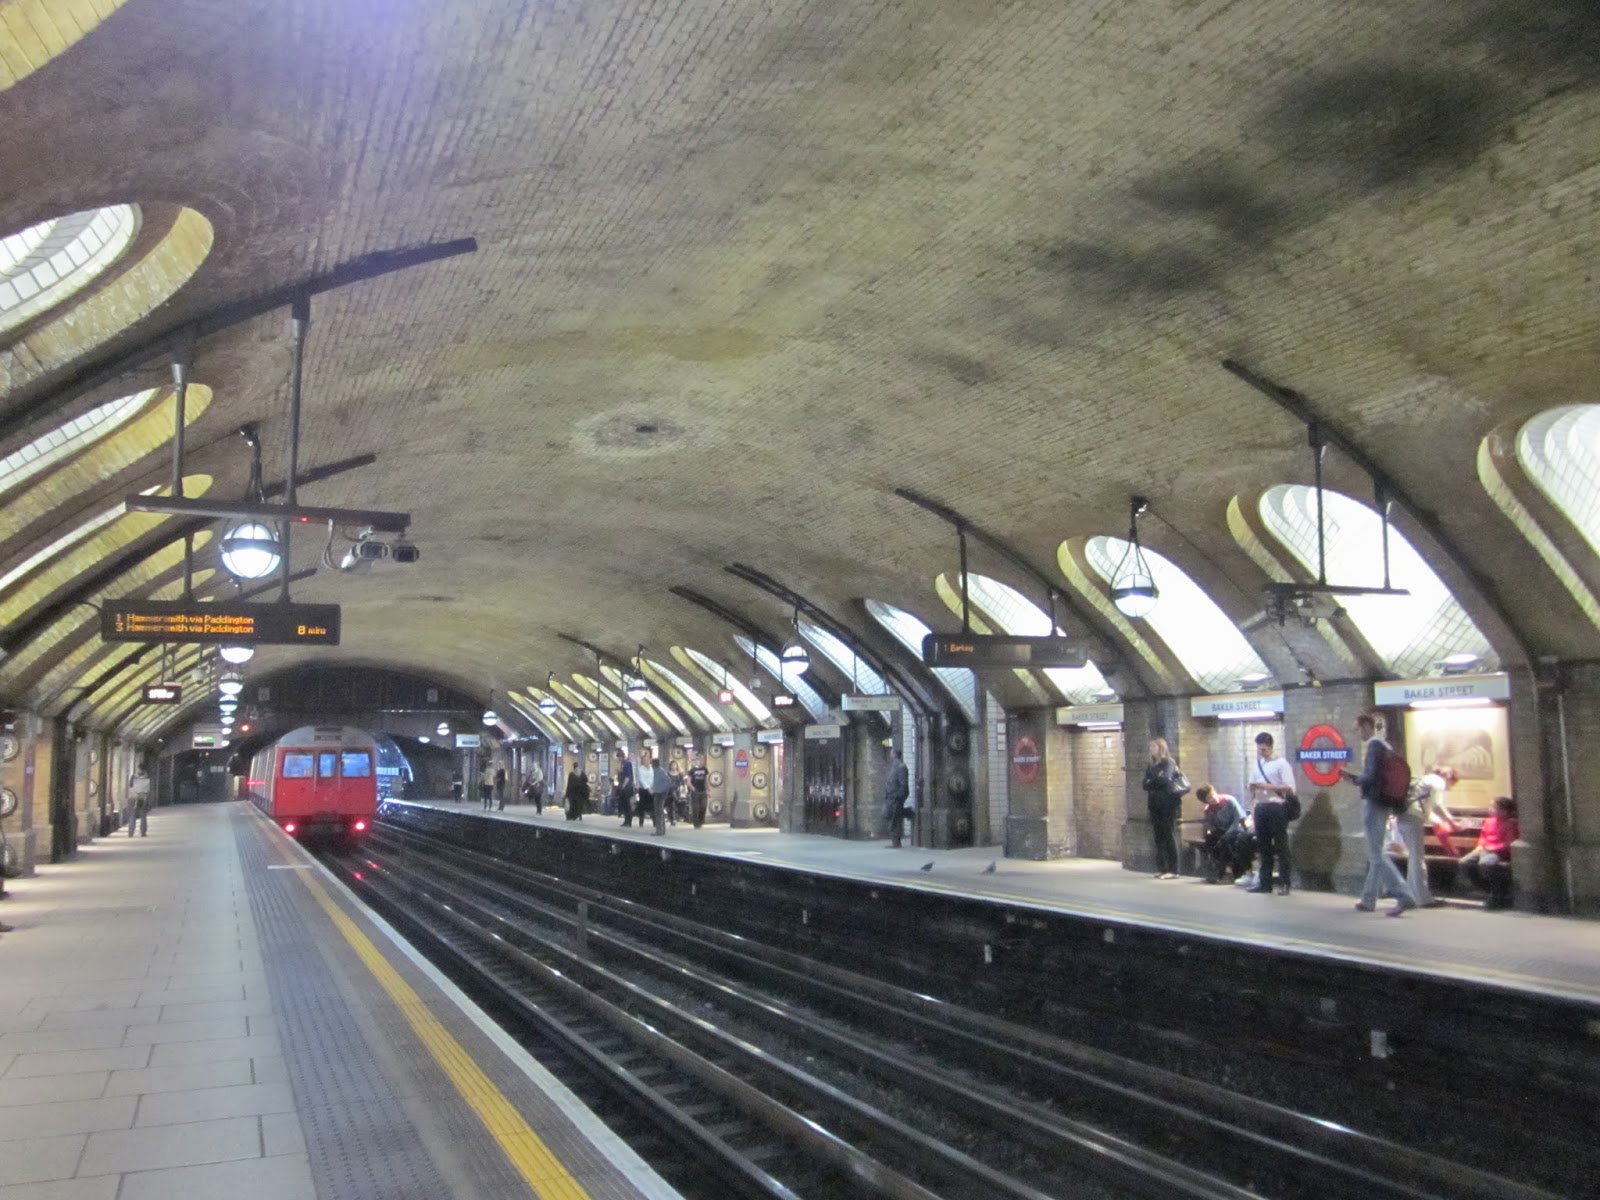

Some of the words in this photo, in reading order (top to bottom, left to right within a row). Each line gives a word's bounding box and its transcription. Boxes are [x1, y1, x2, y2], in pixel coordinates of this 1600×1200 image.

[190, 616, 203, 624] via
[204, 614, 254, 625] Paddington
[116, 622, 123, 632] 3
[190, 625, 203, 633] via
[204, 624, 254, 634] Paddington
[298, 625, 306, 635] 8
[1404, 688, 1434, 699] BAKER
[1438, 685, 1475, 698] STREET
[1211, 702, 1234, 712] BAKER
[1236, 700, 1261, 711] STREET
[1299, 750, 1321, 759] BAKER
[1323, 750, 1347, 759] STREET
